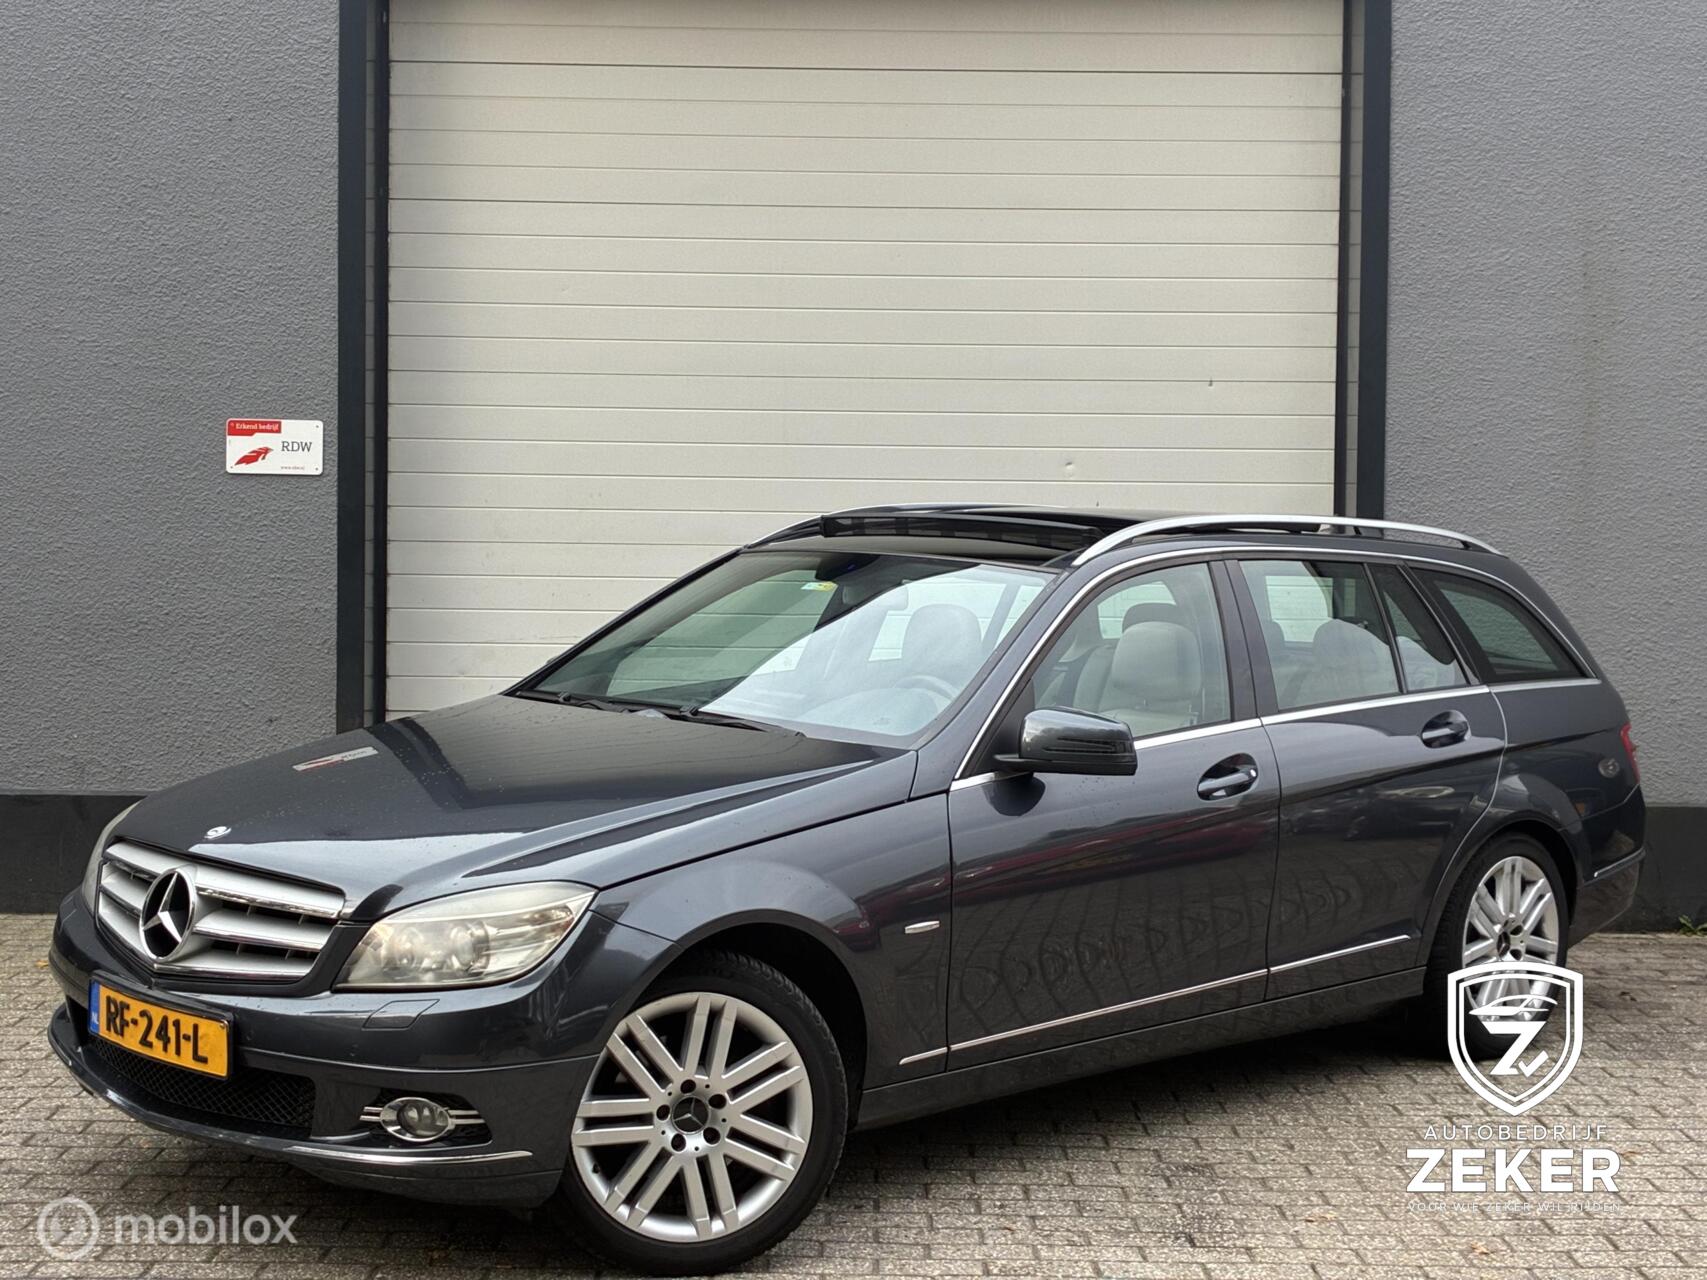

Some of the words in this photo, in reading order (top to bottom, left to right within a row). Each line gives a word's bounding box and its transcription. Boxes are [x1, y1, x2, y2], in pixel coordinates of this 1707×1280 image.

[235, 422, 258, 430] Erkend
[258, 422, 280, 432] bedrijf
[281, 441, 312, 452] RDW
[105, 995, 208, 1065] RF-241-L
